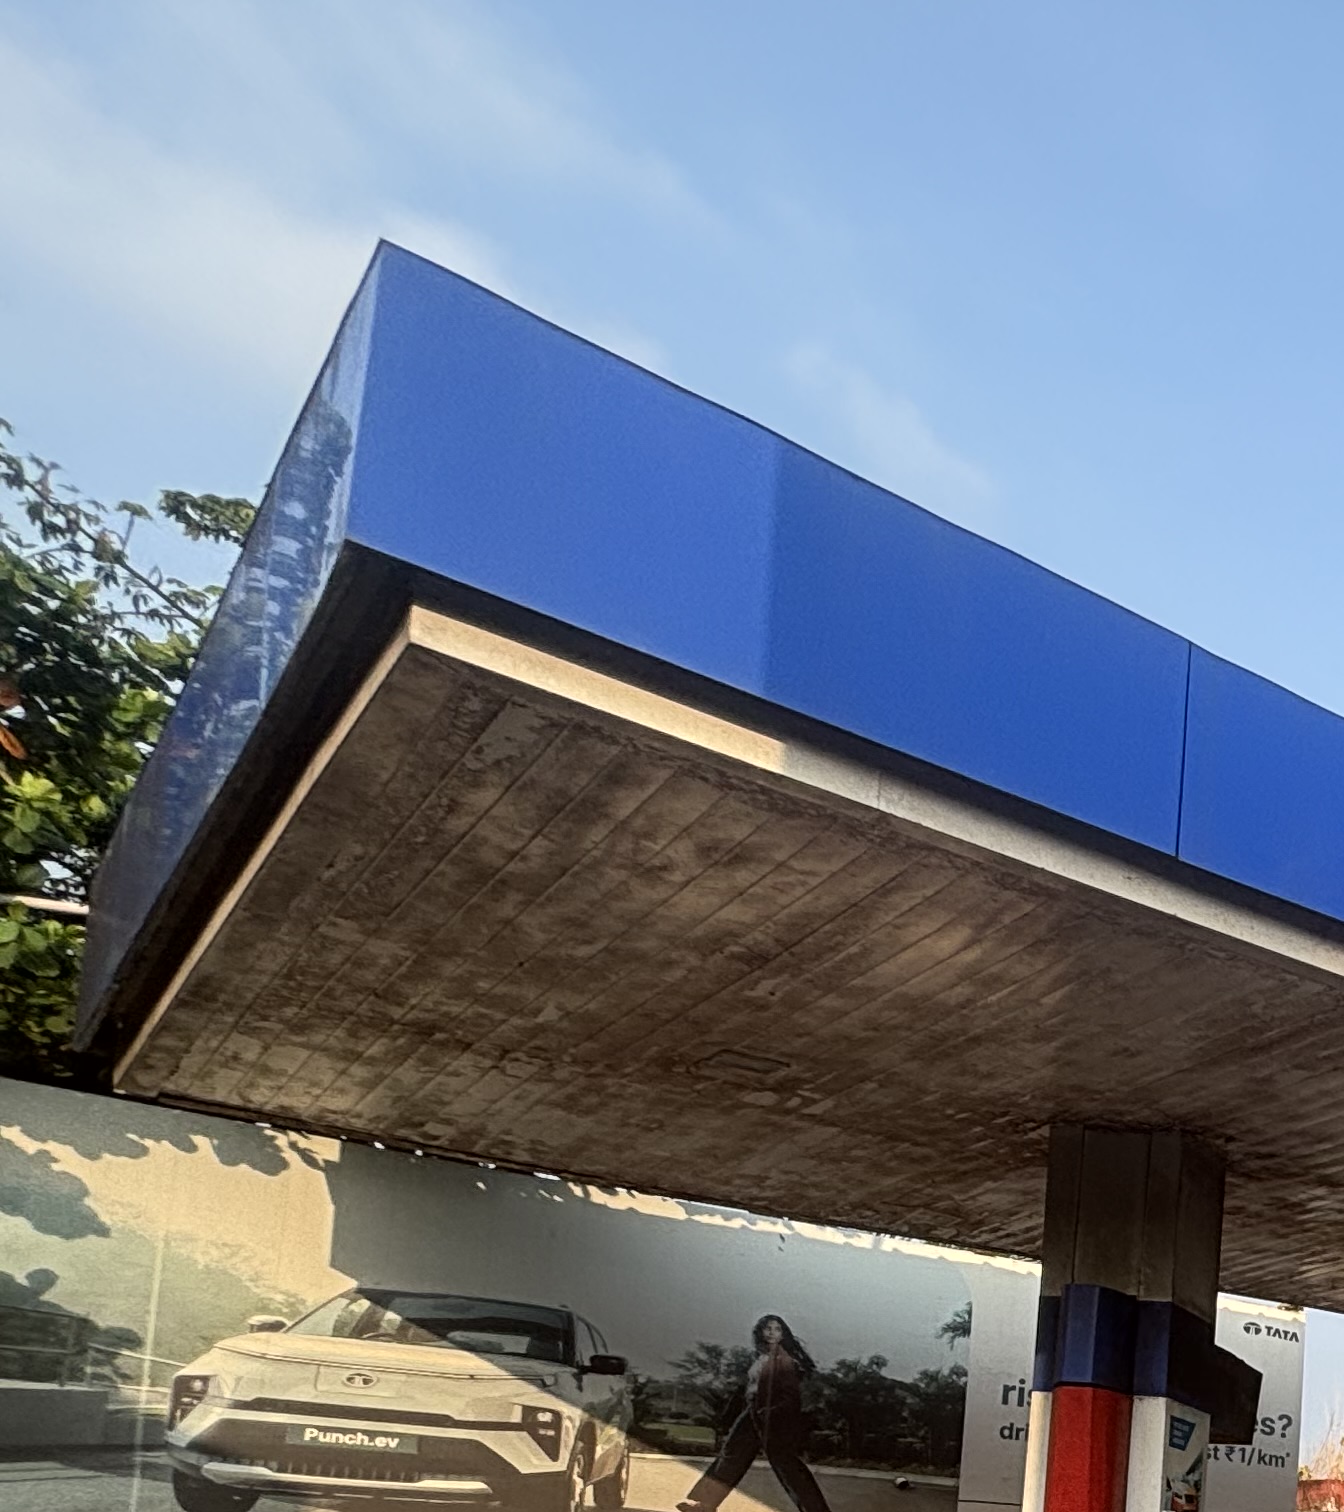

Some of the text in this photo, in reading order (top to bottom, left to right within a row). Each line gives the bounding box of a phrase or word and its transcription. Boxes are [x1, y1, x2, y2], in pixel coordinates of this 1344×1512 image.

[1265, 1325, 1300, 1343] TATA
[1001, 1378, 1031, 1408] ri
[303, 1427, 400, 1449] Punch.ev
